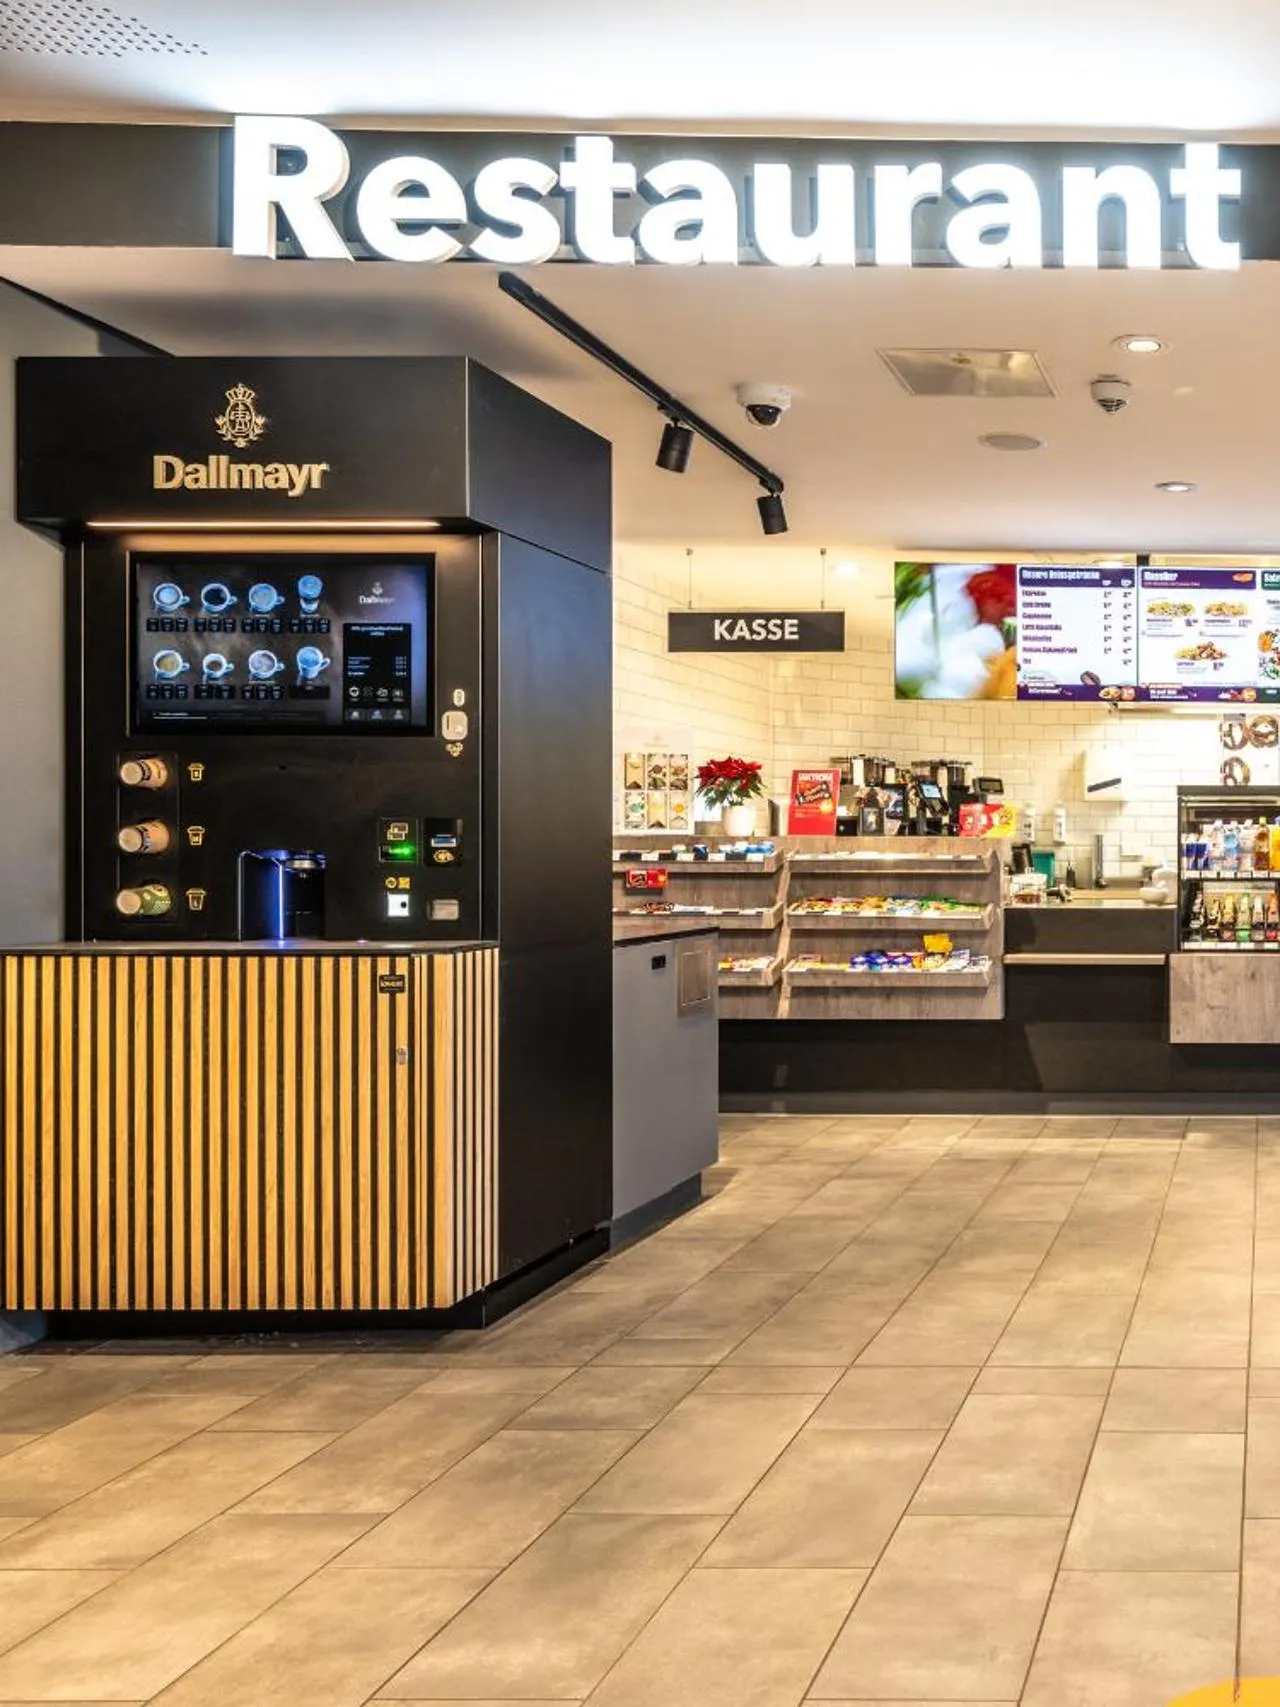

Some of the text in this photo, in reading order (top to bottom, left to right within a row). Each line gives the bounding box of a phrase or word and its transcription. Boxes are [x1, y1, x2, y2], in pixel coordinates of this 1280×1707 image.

[232, 115, 1242, 269] Restaurant
[153, 455, 330, 498] Dallmayr
[713, 619, 800, 641] KASSE
